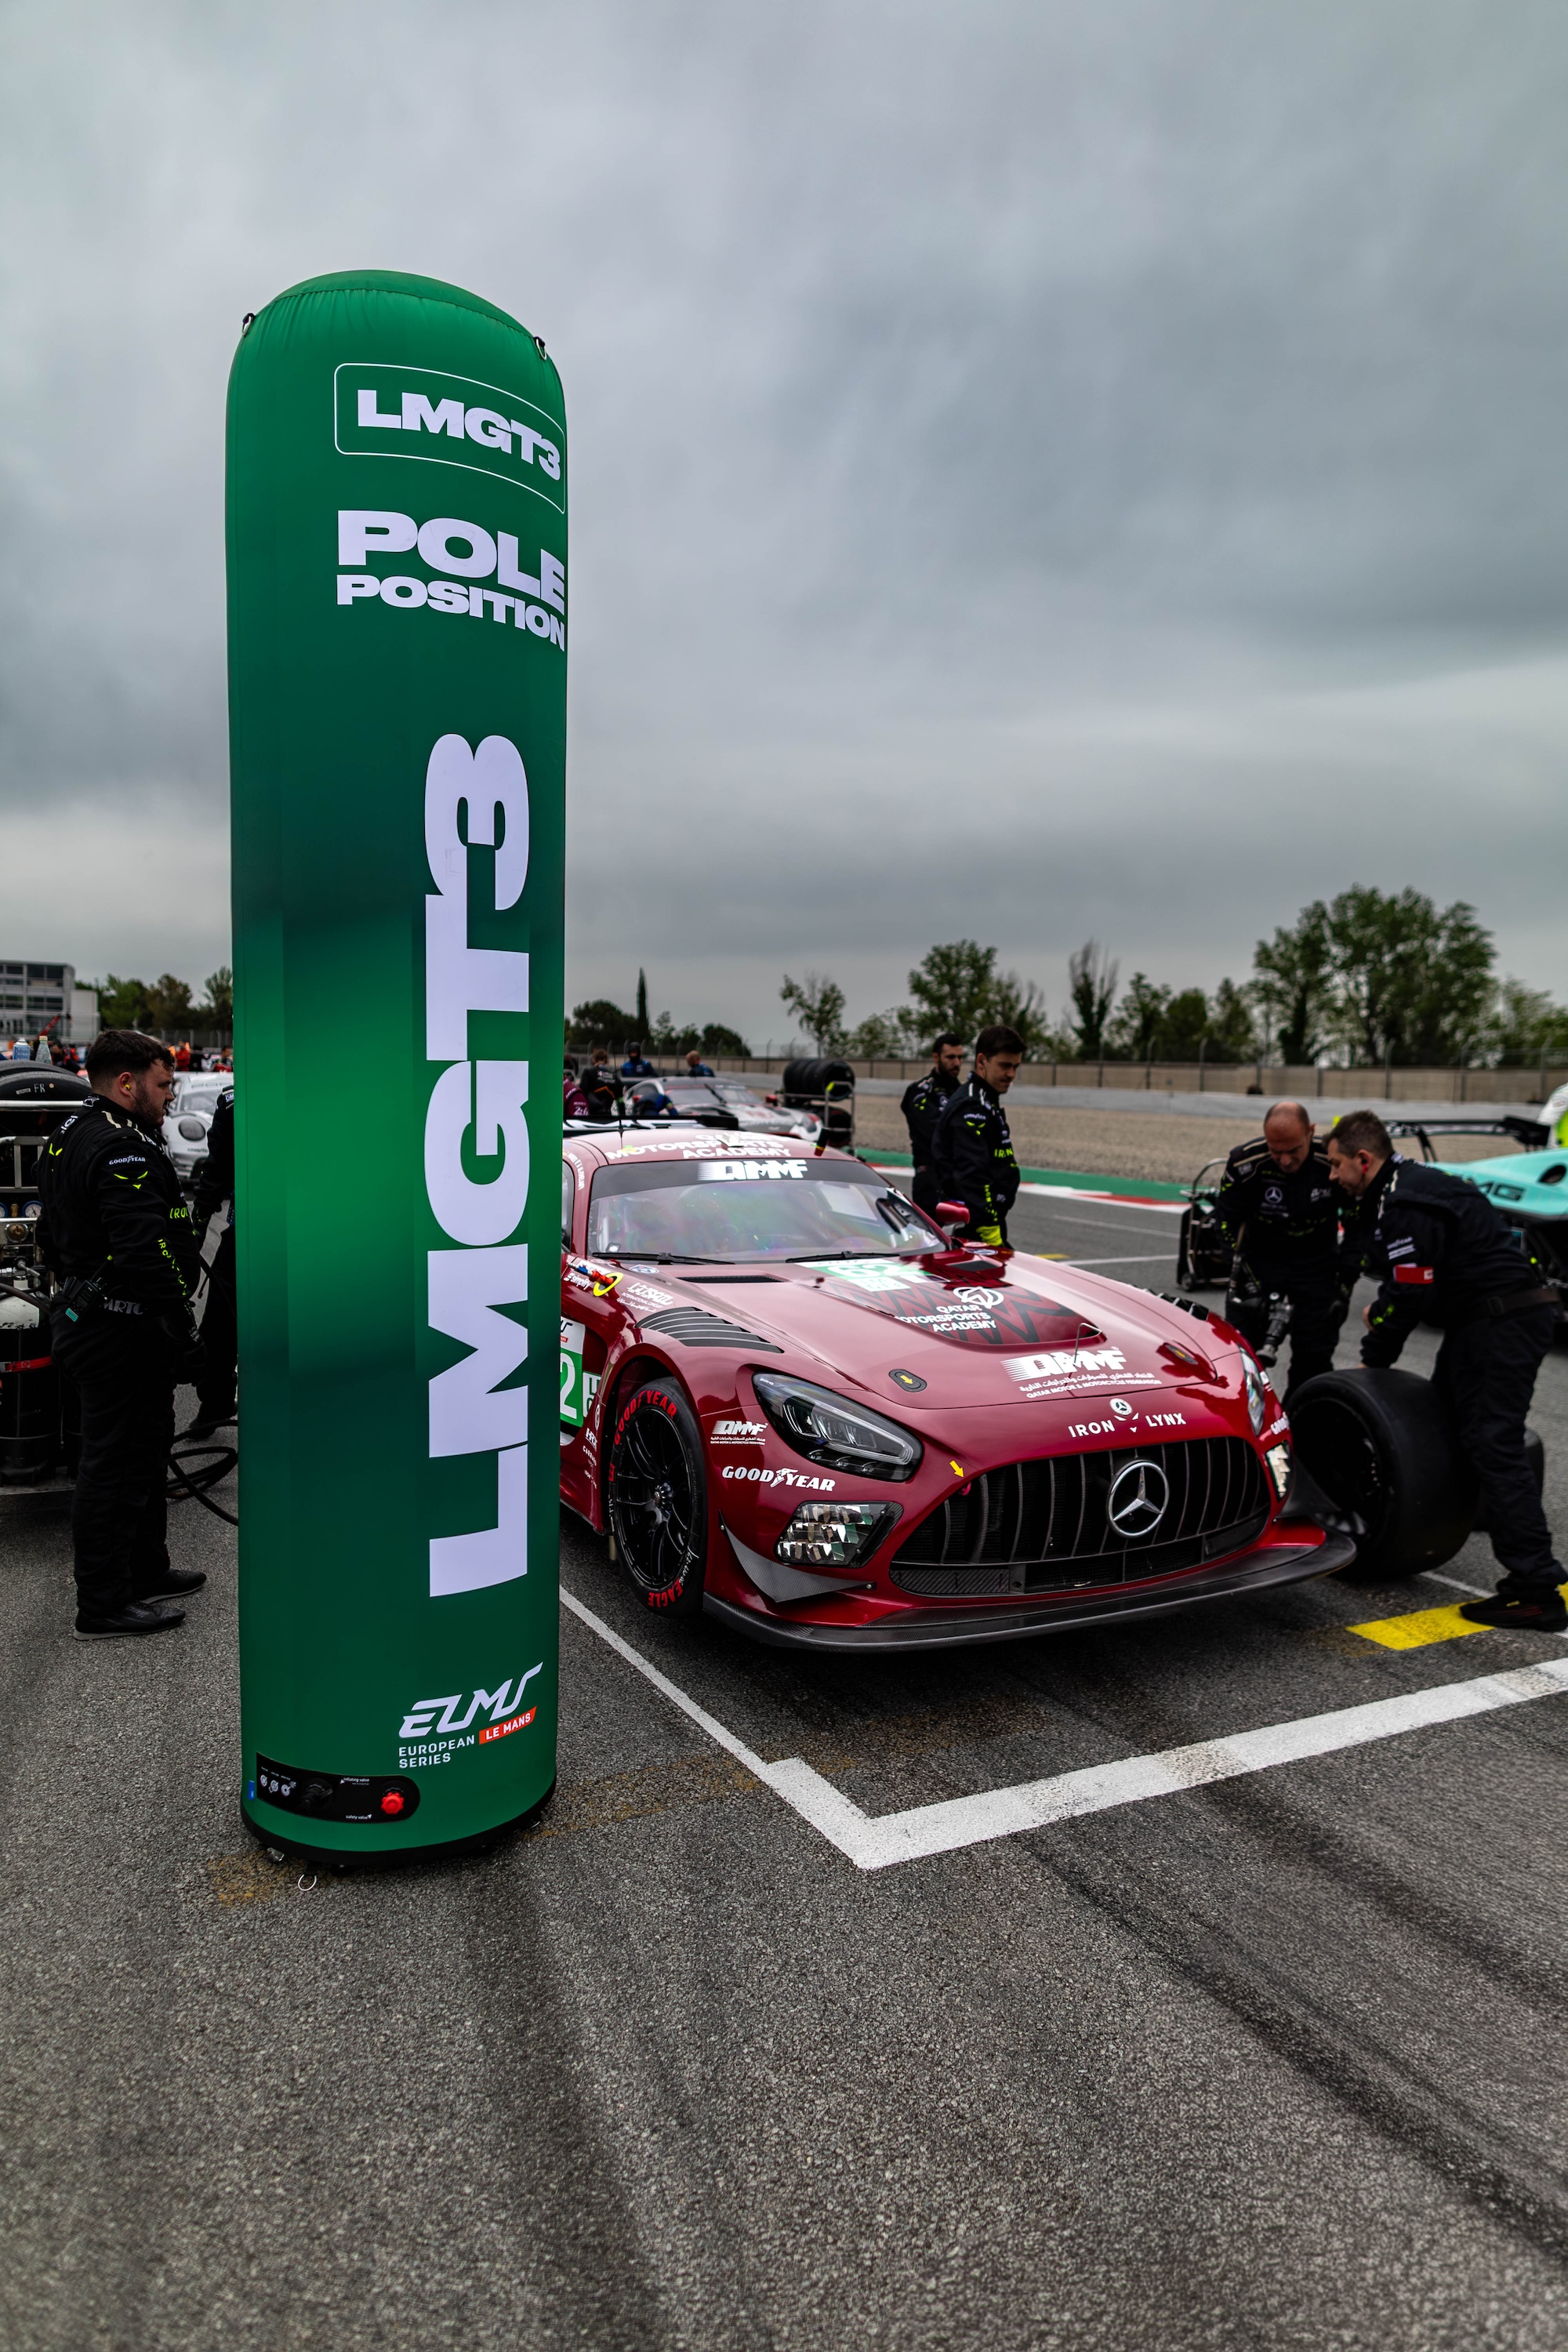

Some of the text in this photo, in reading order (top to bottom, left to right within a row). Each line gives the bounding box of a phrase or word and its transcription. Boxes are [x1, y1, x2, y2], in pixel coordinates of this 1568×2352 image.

[358, 389, 561, 481] LMGT3
[338, 510, 565, 616] POLE
[336, 574, 565, 652] POSITION
[604, 1140, 784, 1160] MOTORSPRTS
[682, 1148, 791, 1159] ACADEMY
[109, 1156, 146, 1165] GOODYEAR
[425, 733, 530, 1597] LMGT3
[698, 1160, 808, 1180] QMMF
[169, 1207, 188, 1219] IRO
[827, 1263, 922, 1278] 62
[571, 1273, 592, 1290] simplify
[936, 1305, 982, 1313] QATAR
[933, 1320, 996, 1332] ACADEMY
[1002, 1350, 1127, 1382] QMMF
[1026, 1388, 1051, 1398] QATAR
[1051, 1385, 1076, 1394] MOTOR
[1083, 1380, 1126, 1388] MOTORCYCLE
[615, 1390, 677, 1445] GOODYEAR
[1068, 1413, 1186, 1438] IRON LYNX
[712, 1420, 768, 1436] QMMF
[722, 1466, 837, 1492] GOODYEAR
[648, 1577, 684, 1607] EAGLE
[398, 1712, 532, 1757] EUROPEAN LE MANS
[398, 1752, 451, 1769] SERIES
